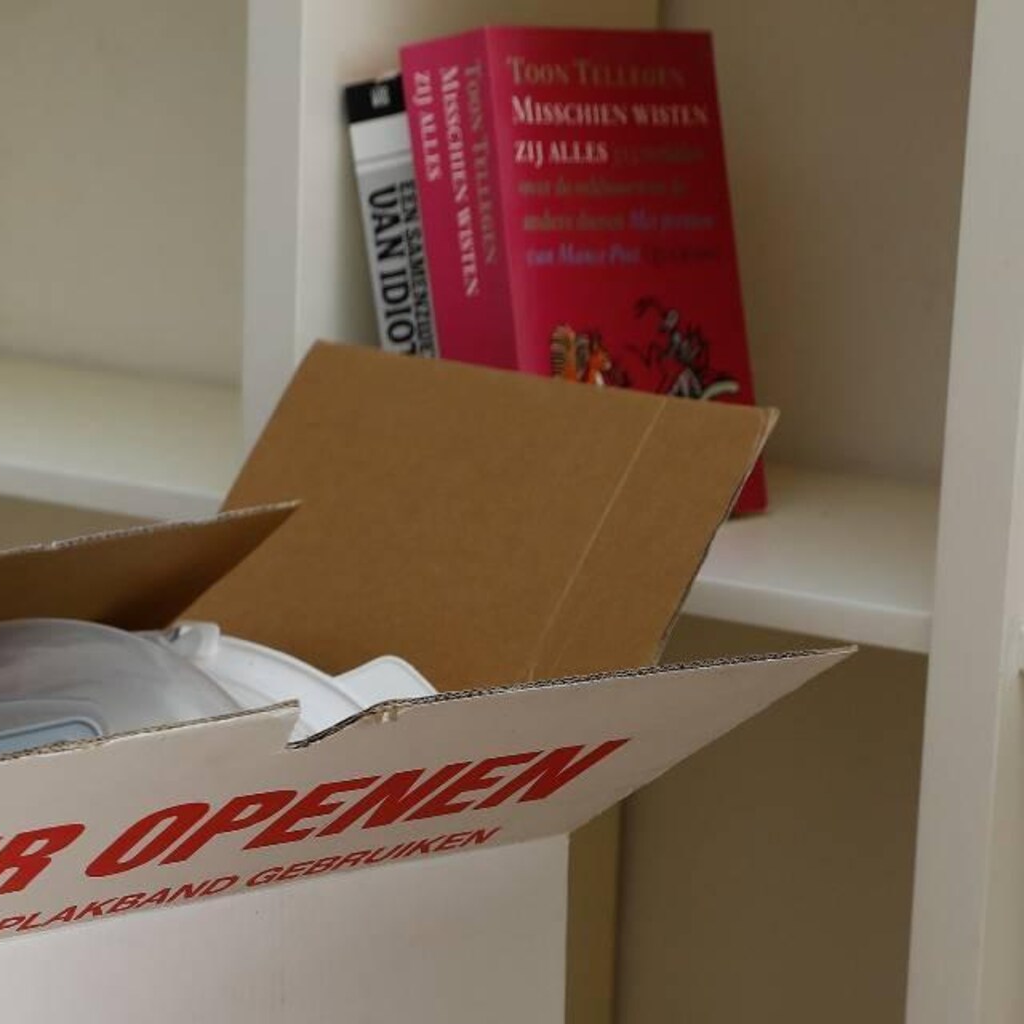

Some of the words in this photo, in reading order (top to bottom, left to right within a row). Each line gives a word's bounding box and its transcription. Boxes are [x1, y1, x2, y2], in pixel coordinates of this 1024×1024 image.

[549, 140, 608, 163] ALLES
[84, 737, 631, 880] OPENEN
[246, 826, 501, 888] GEBRUIKEN
